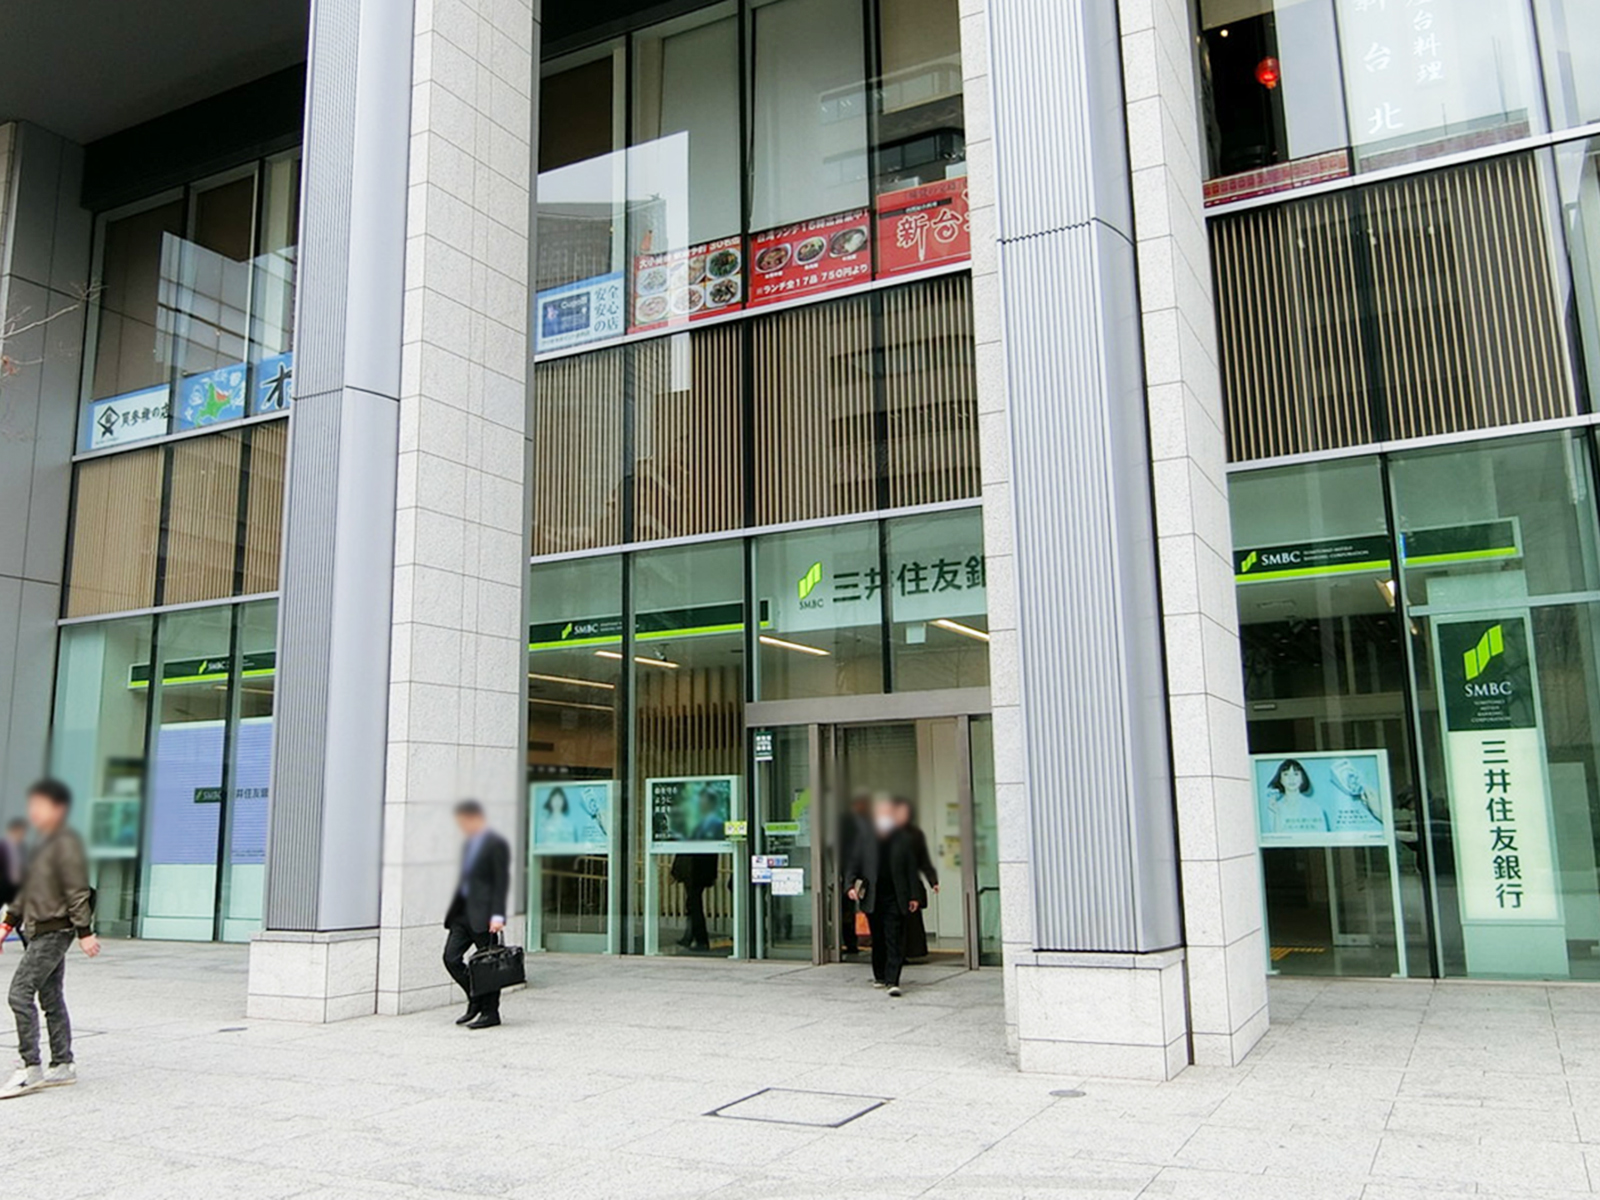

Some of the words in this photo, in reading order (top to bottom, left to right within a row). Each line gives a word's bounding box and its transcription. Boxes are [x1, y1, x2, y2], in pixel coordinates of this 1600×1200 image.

[897, 207, 971, 261] 新台
[1261, 550, 1301, 566] SMBC
[799, 599, 824, 610] SMBC
[574, 623, 599, 635] SMBC
[1464, 681, 1512, 698] SMBC
[1481, 740, 1524, 909] 三井住友銀行
